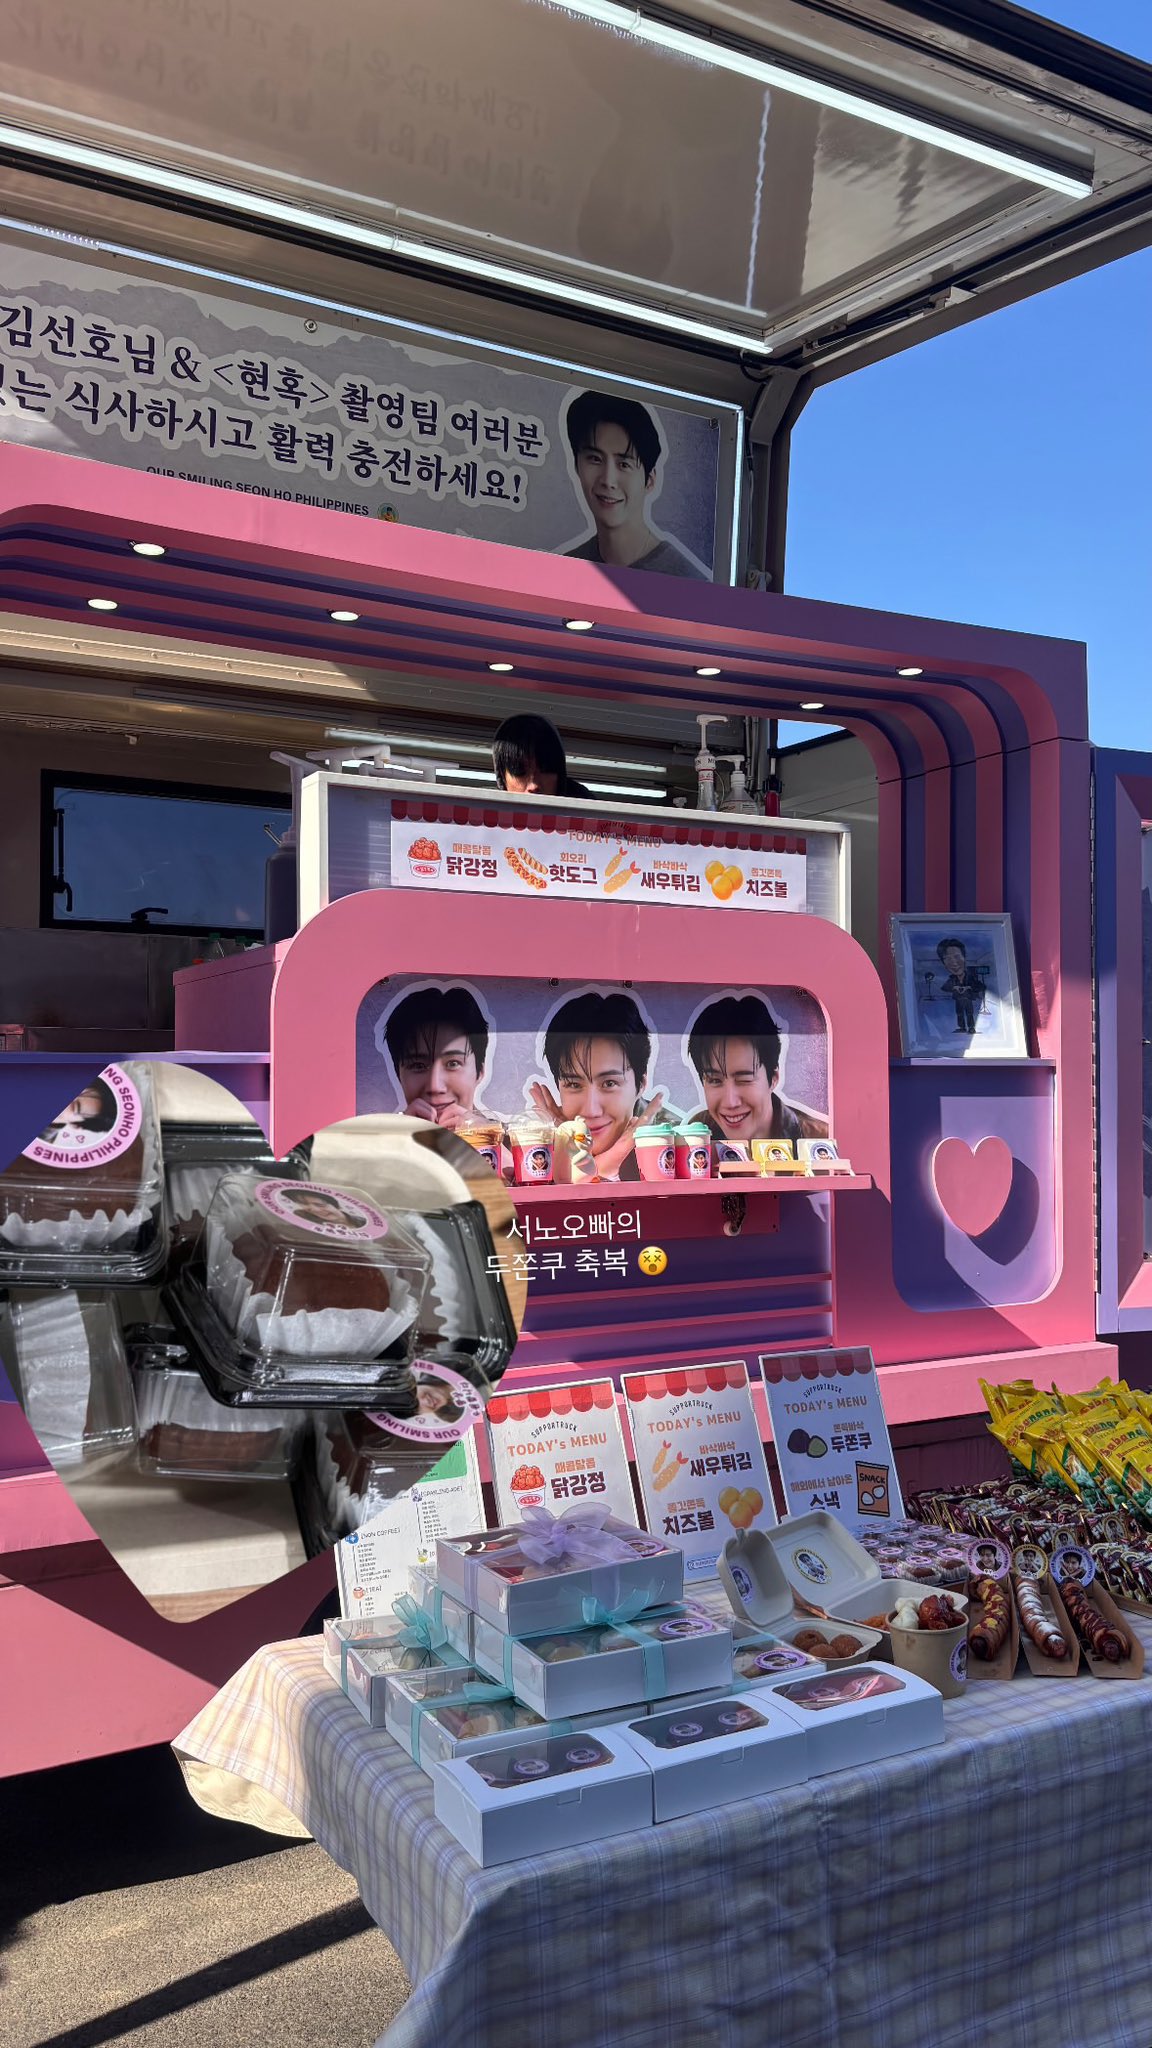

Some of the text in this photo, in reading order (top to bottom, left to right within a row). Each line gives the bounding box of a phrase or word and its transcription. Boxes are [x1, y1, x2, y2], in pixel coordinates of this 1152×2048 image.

[0, 305, 544, 459] 김선호님 & <현혹> 촬영팀 여러분
[0, 363, 521, 504] 는 식사하시고 활력 충전하세요!
[235, 482, 270, 498] SEON
[274, 488, 292, 502] HO
[295, 493, 369, 516] PHILIPPINES
[446, 856, 498, 878] 닭강정
[559, 852, 587, 864] 회오리
[549, 864, 598, 885] 핫도그
[640, 871, 701, 893] 새우튀김
[746, 879, 788, 899] 치즈볼
[118, 1087, 135, 1138] SEONHO
[33, 1137, 122, 1163] PHILIPPINES
[784, 1395, 868, 1415] TODAY's MENU
[376, 1413, 460, 1439] OUR SMILING
[647, 1410, 742, 1434] TODAY's MENU
[507, 1432, 607, 1457] TODAY's MENU
[830, 1432, 872, 1453] 두쫀쿠
[690, 1451, 753, 1477] 새우튀김
[550, 1471, 606, 1499] 닭강정
[859, 1472, 886, 1484] SNACK
[809, 1490, 841, 1511] 스낵
[662, 1510, 715, 1536] 치즈볼
